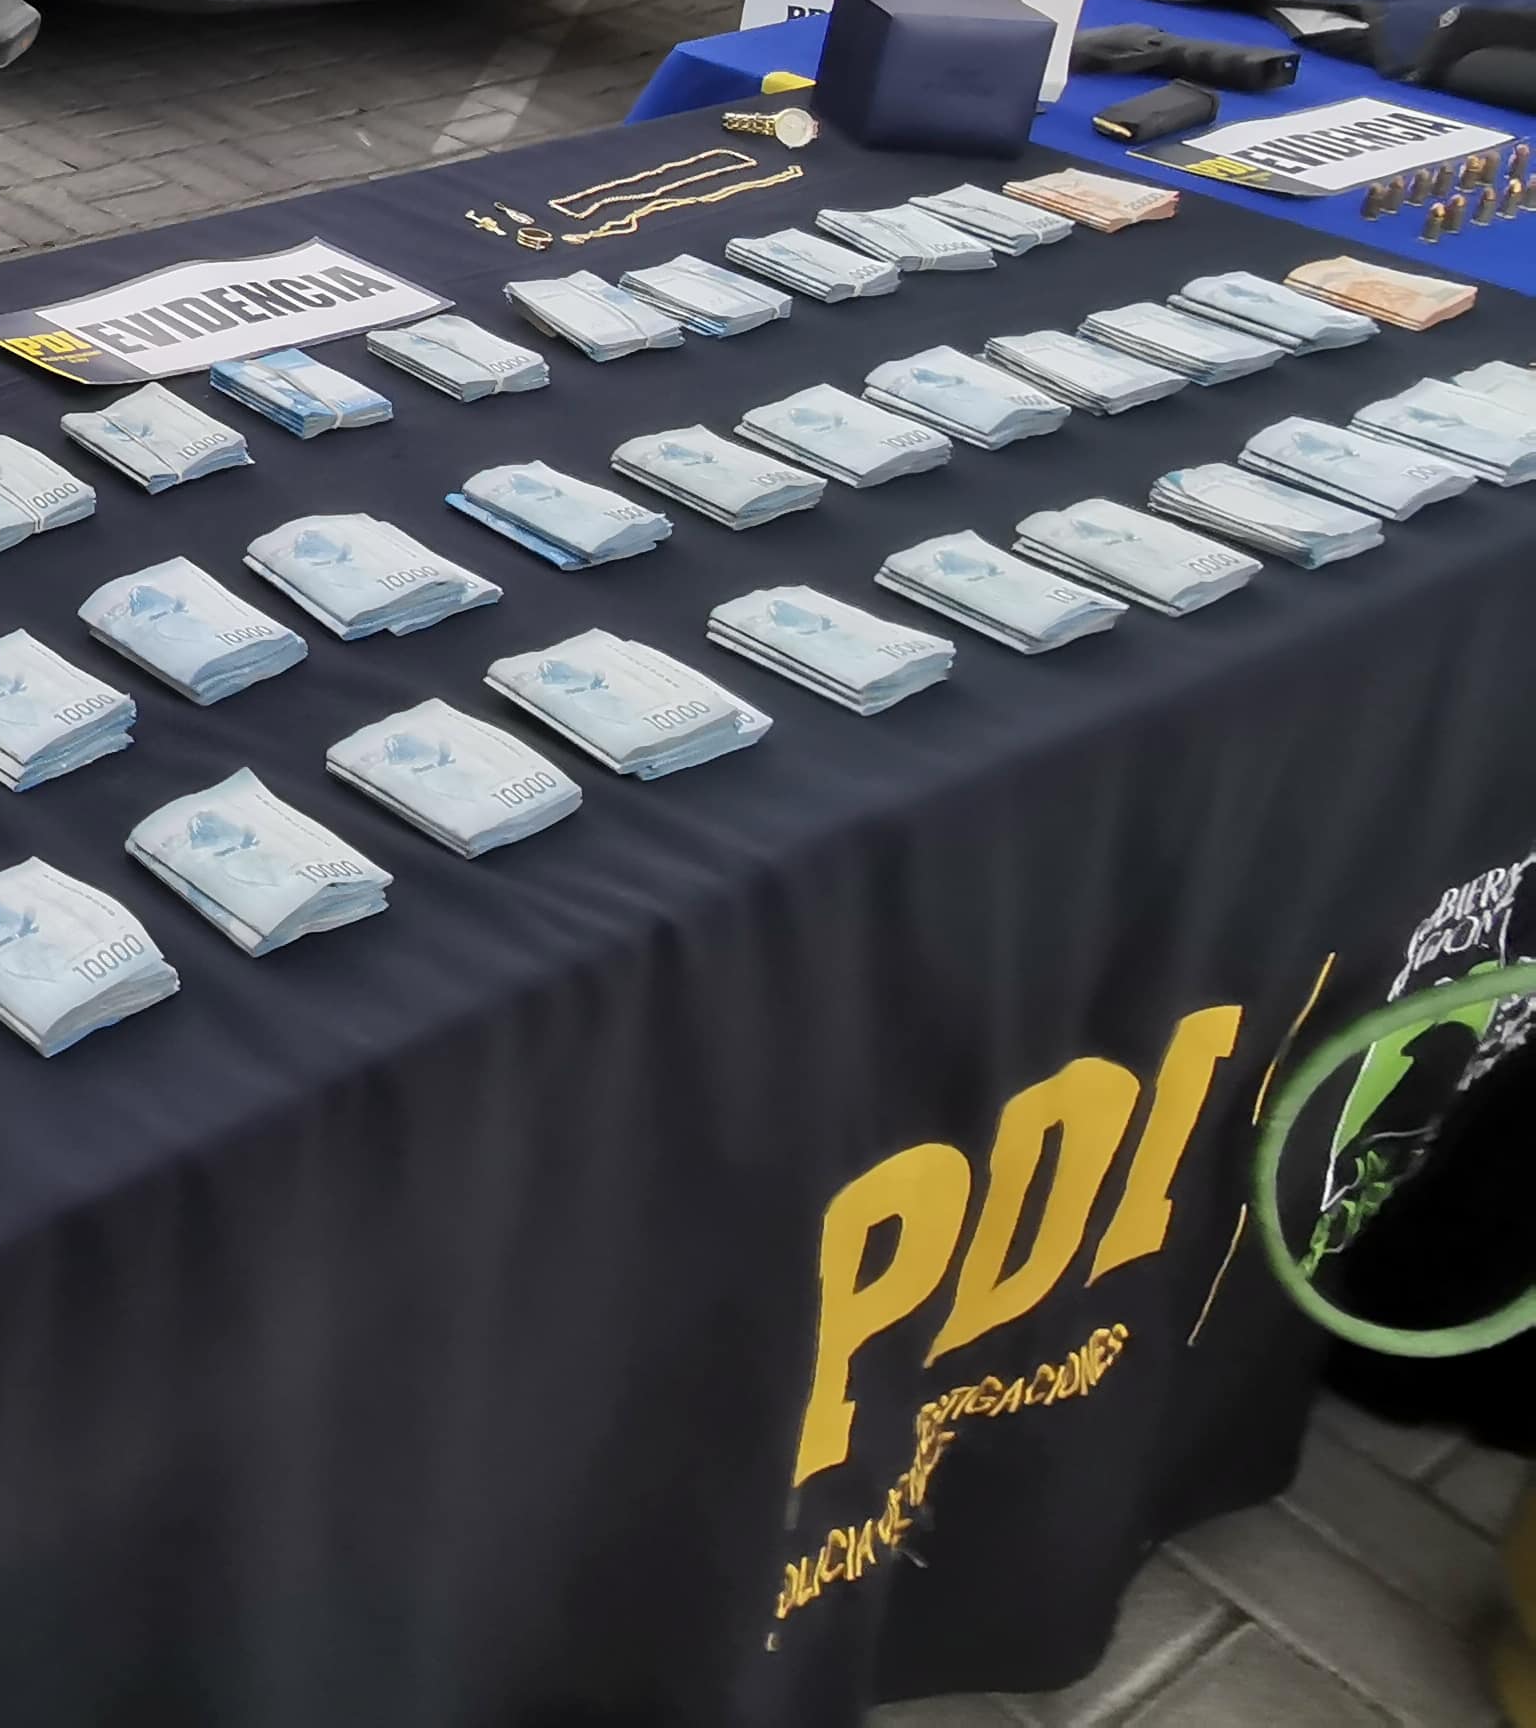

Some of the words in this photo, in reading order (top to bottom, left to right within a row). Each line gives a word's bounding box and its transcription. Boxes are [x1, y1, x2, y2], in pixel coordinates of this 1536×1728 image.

[1230, 112, 1465, 174] EVIDENCIA
[5, 330, 93, 359] PDI
[77, 265, 397, 354] EVIDENCIA
[54, 693, 114, 727] 10000
[642, 700, 711, 731] 10000
[72, 933, 145, 985] 10000
[793, 1005, 1242, 1486] PDI
